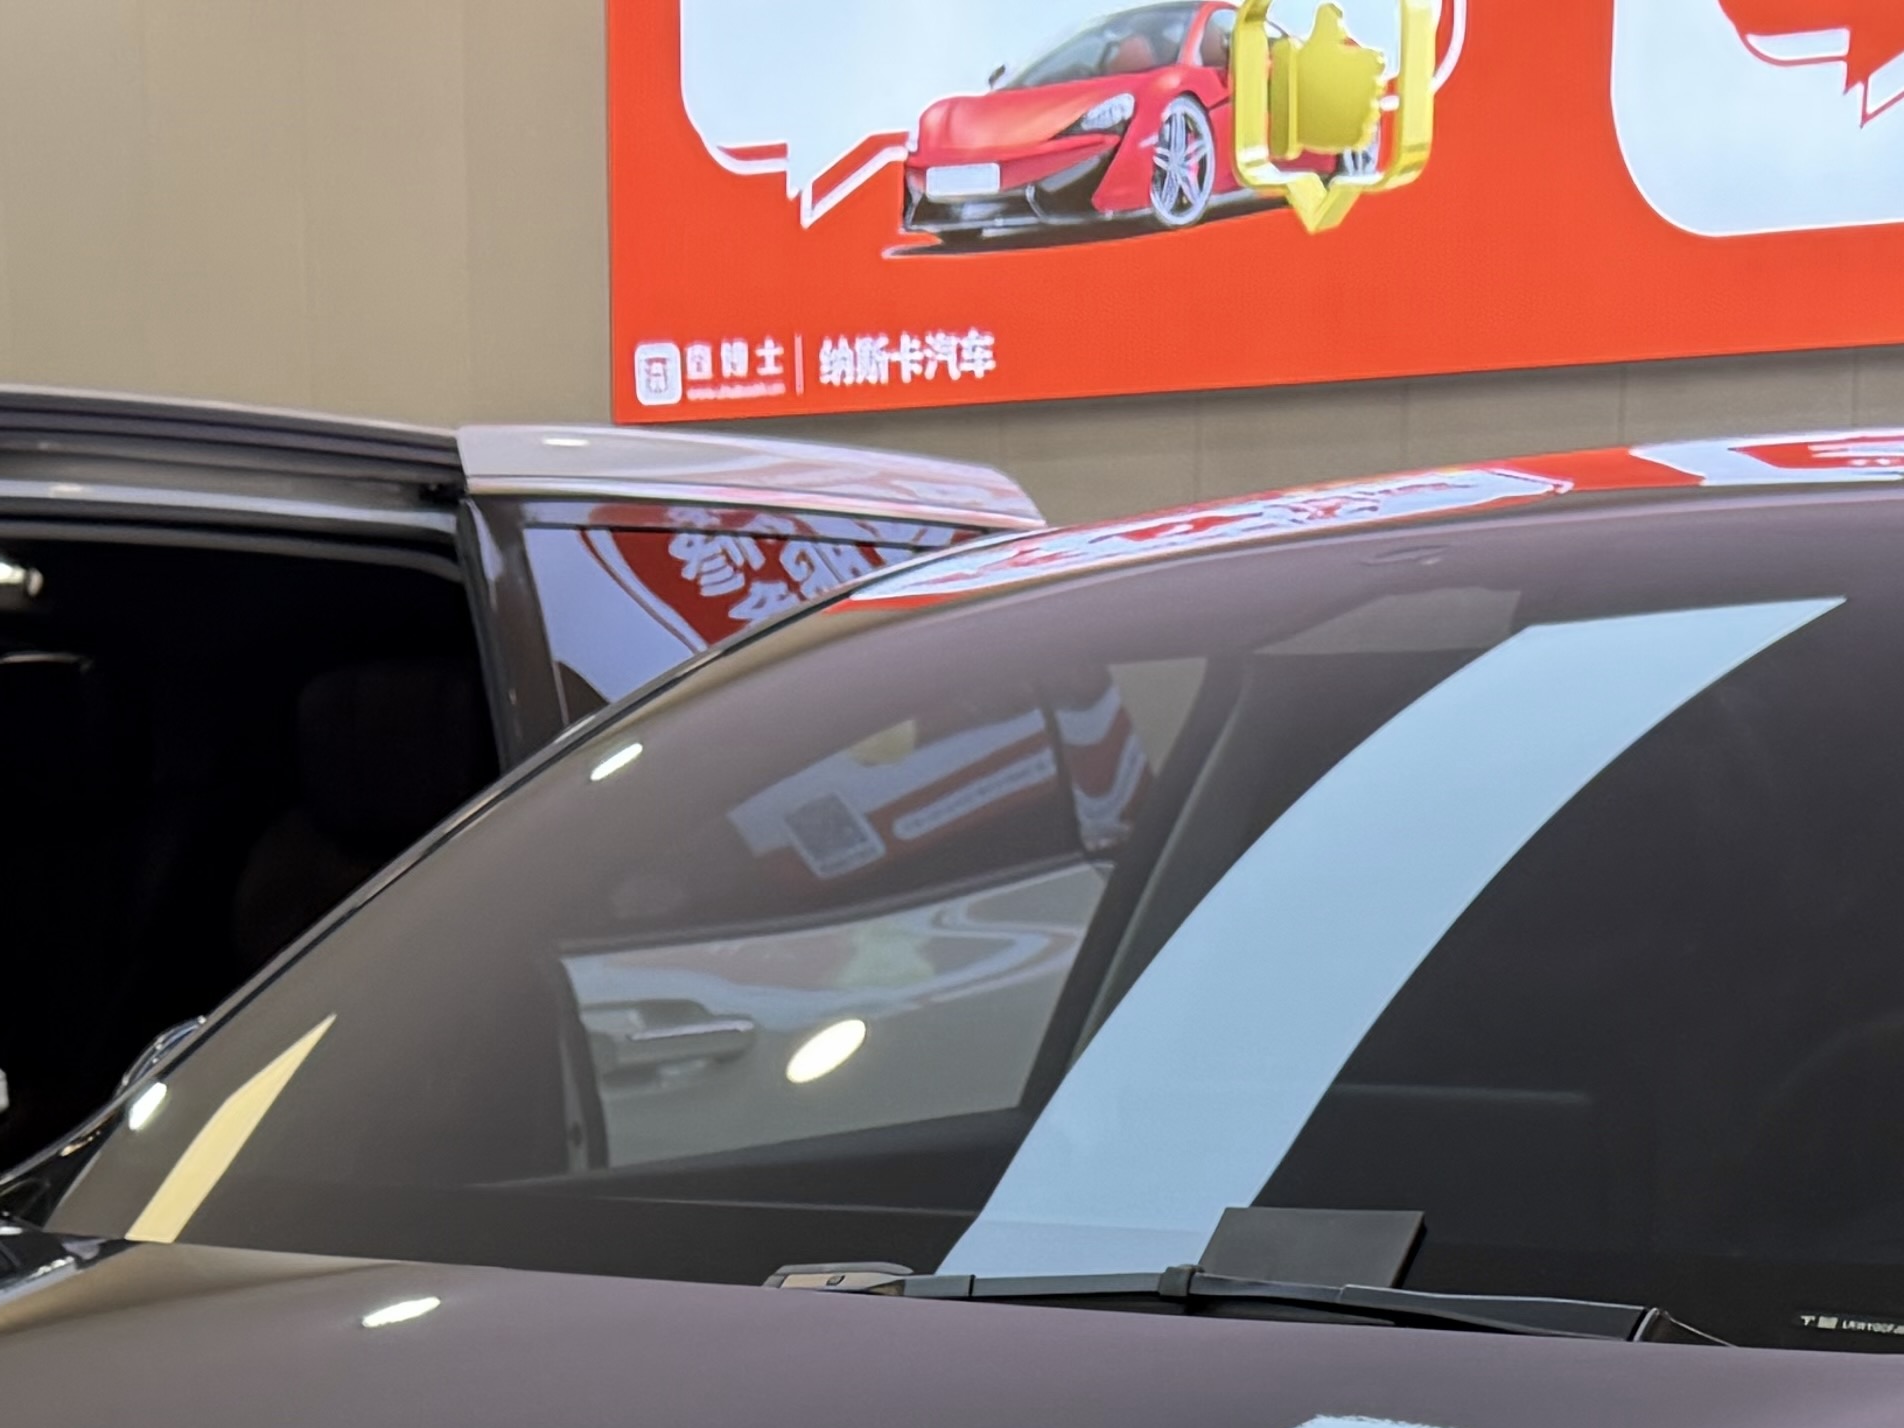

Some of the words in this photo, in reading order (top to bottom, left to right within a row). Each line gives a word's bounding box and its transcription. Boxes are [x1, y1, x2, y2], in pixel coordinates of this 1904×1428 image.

[819, 327, 995, 386] 纳斯卡汽车
